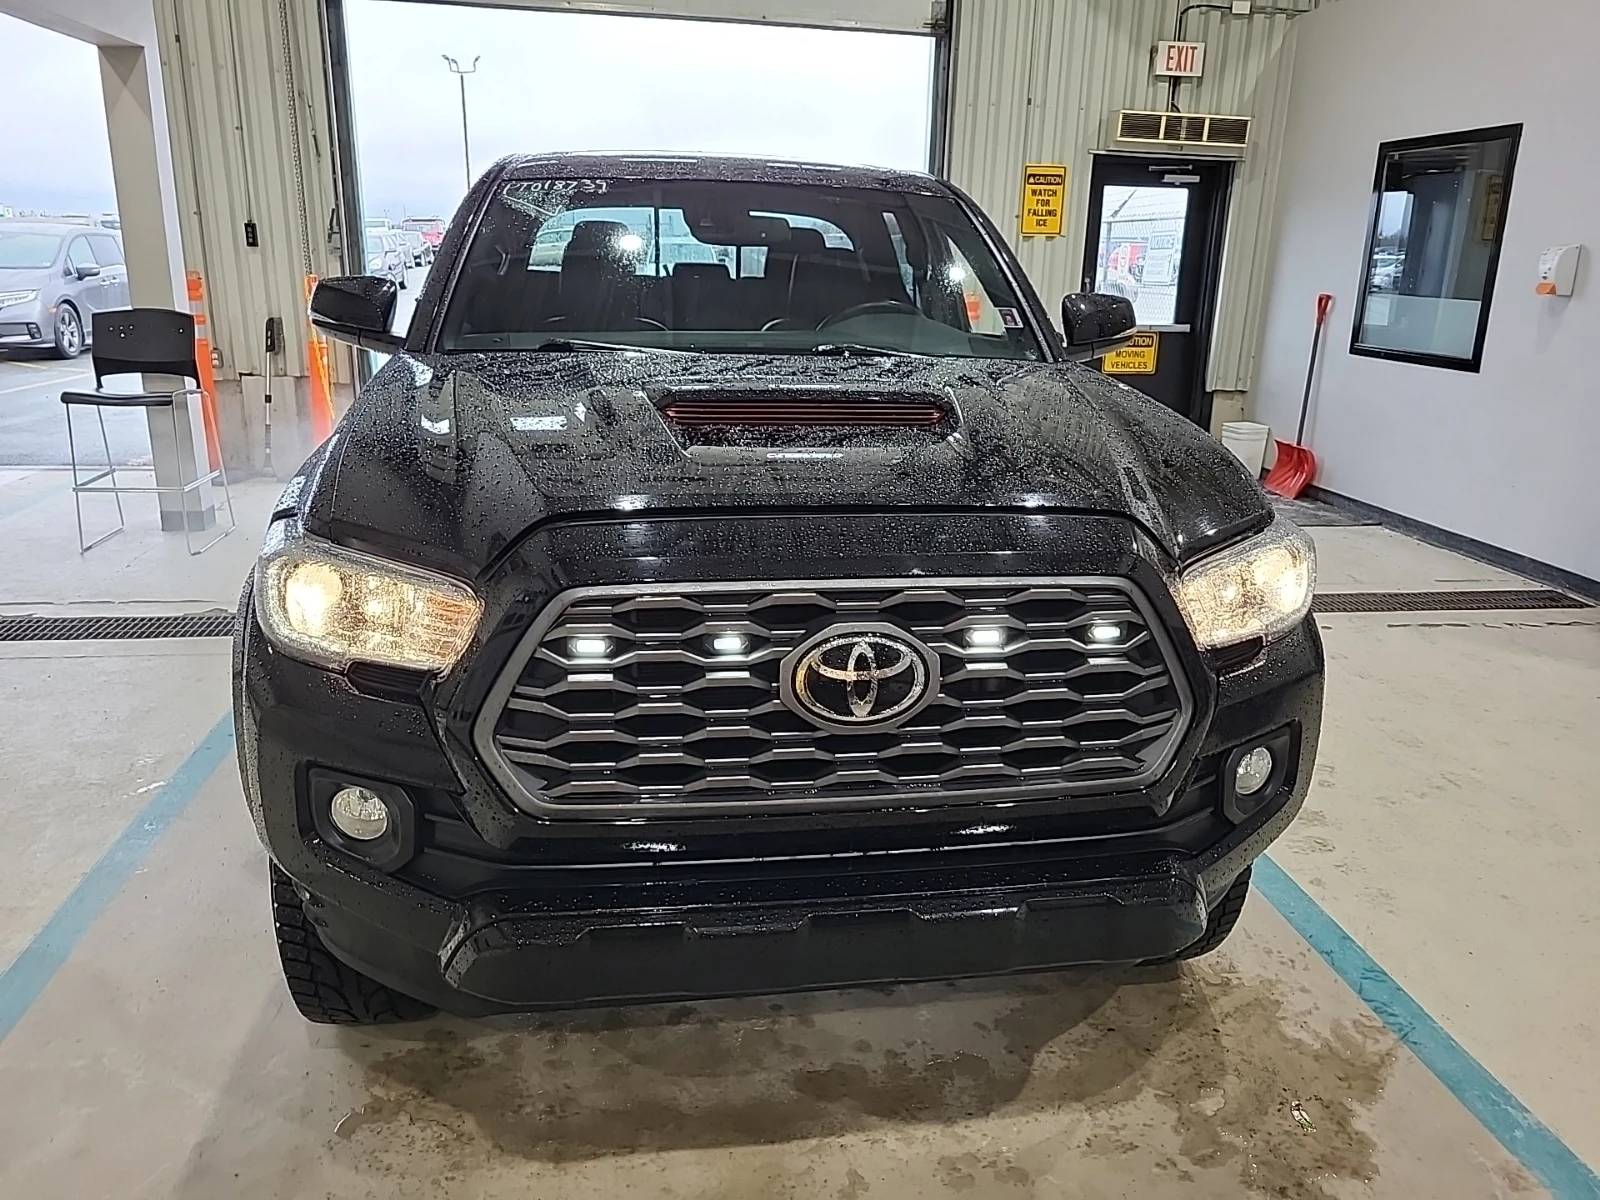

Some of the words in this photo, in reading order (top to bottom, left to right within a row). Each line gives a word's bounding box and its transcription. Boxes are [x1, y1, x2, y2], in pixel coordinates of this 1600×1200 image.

[1165, 45, 1198, 72] EXIT
[1034, 175, 1062, 184] CAUTION
[1030, 188, 1058, 197] WATCH
[1036, 199, 1051, 207] FOR
[1027, 208, 1057, 217] FALLING
[1035, 218, 1048, 227] ICE
[1129, 337, 1153, 346] UTION
[1115, 350, 1146, 358] MOVING
[1111, 361, 1148, 369] VEHICLES
